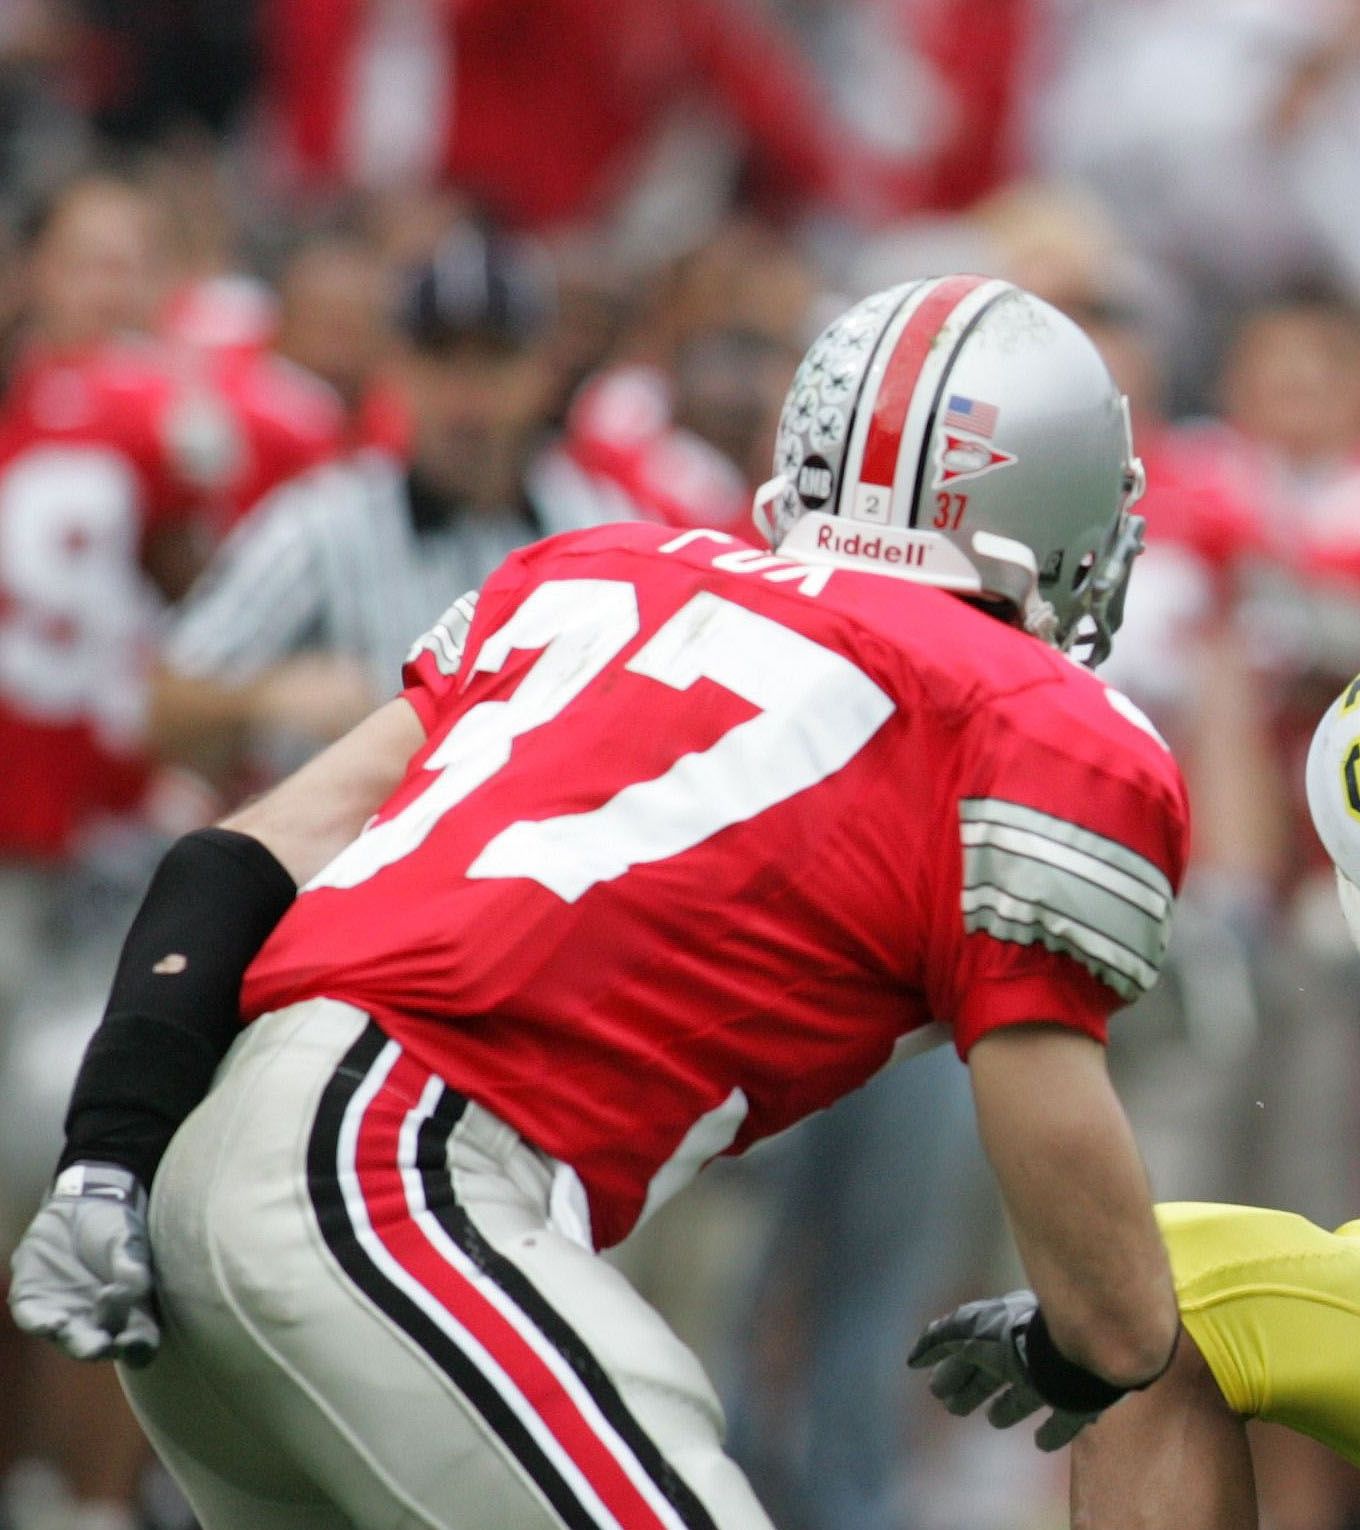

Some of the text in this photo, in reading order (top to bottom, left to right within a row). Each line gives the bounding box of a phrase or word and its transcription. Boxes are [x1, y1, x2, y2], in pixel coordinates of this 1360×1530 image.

[866, 495, 880, 515] 2
[933, 490, 968, 531] 37
[817, 524, 926, 566] Riddell
[298, 578, 898, 905] 37
